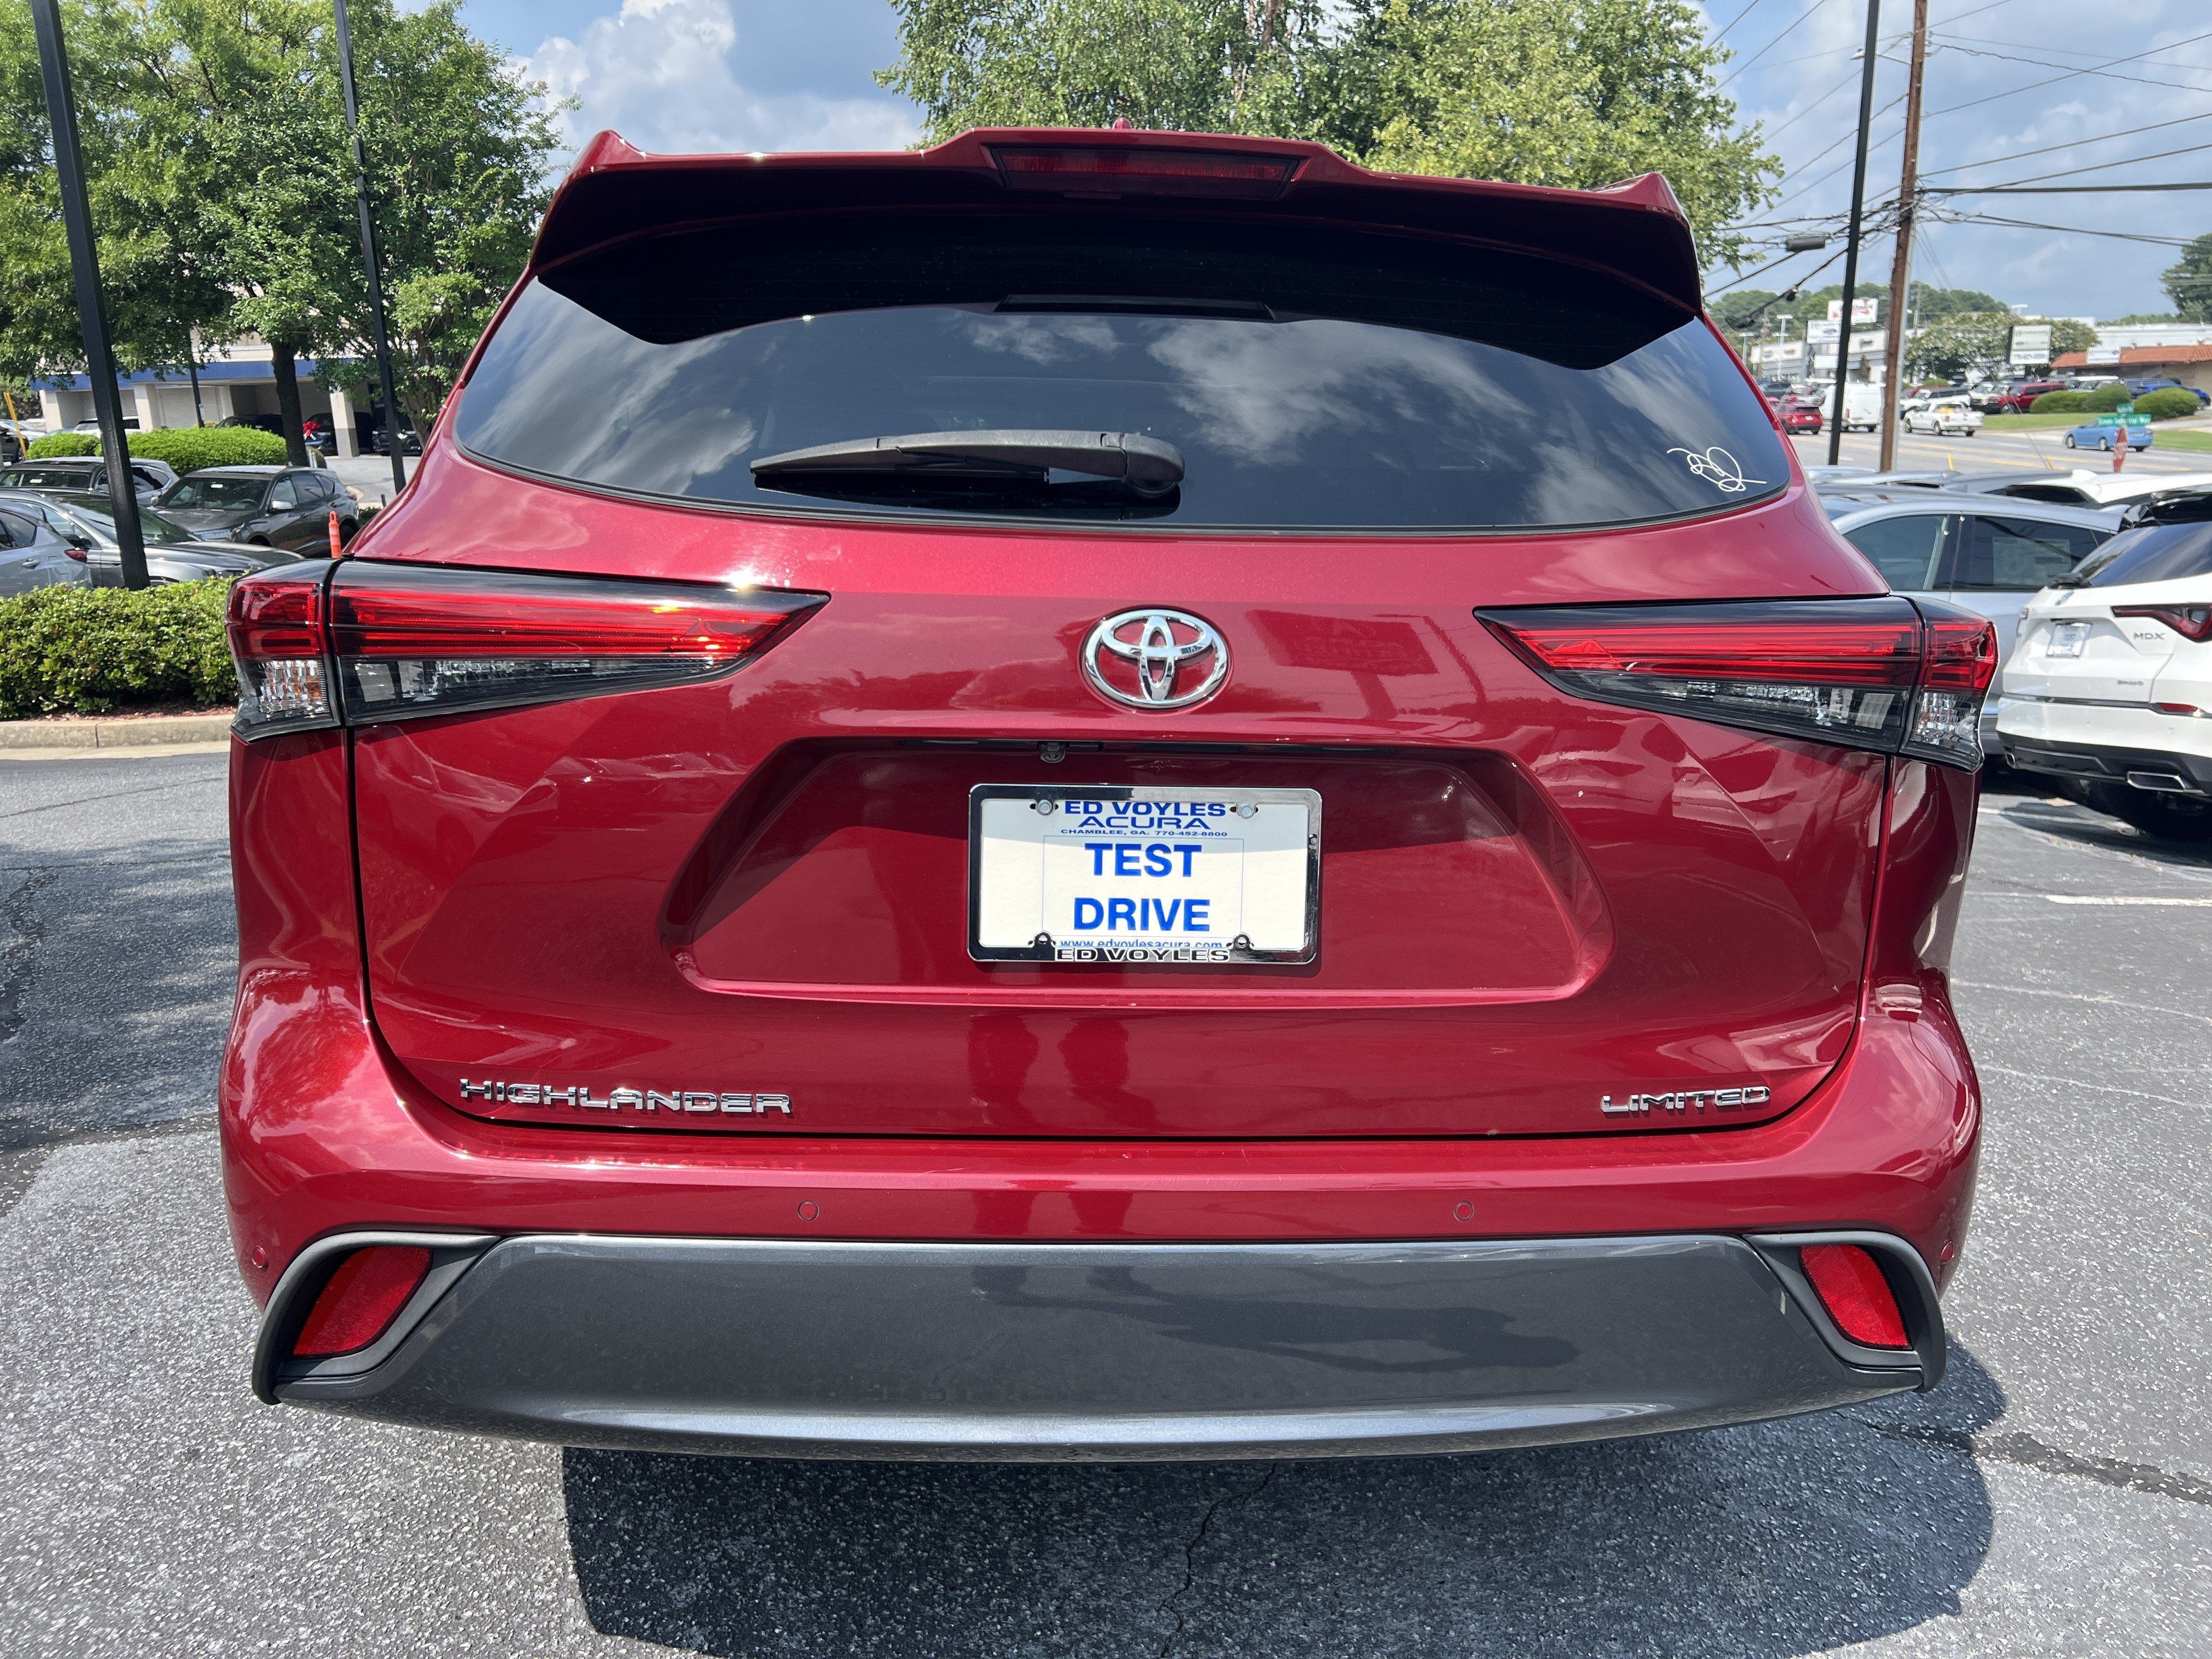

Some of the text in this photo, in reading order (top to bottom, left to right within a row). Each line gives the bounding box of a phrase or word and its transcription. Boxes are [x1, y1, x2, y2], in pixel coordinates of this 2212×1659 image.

[2134, 632, 2165, 640] MDX
[1065, 801, 1226, 816] ED VOYLES
[1077, 816, 1211, 830] ACURA
[1085, 843, 1202, 877] TEST
[1074, 898, 1210, 932] DRIVE
[1060, 938, 1222, 947] wwwedvoylesacuracom
[1055, 948, 1231, 962] ED VOYLES
[460, 1078, 794, 1113] HIGHLANDER
[1601, 1086, 1770, 1112] LIMITED
